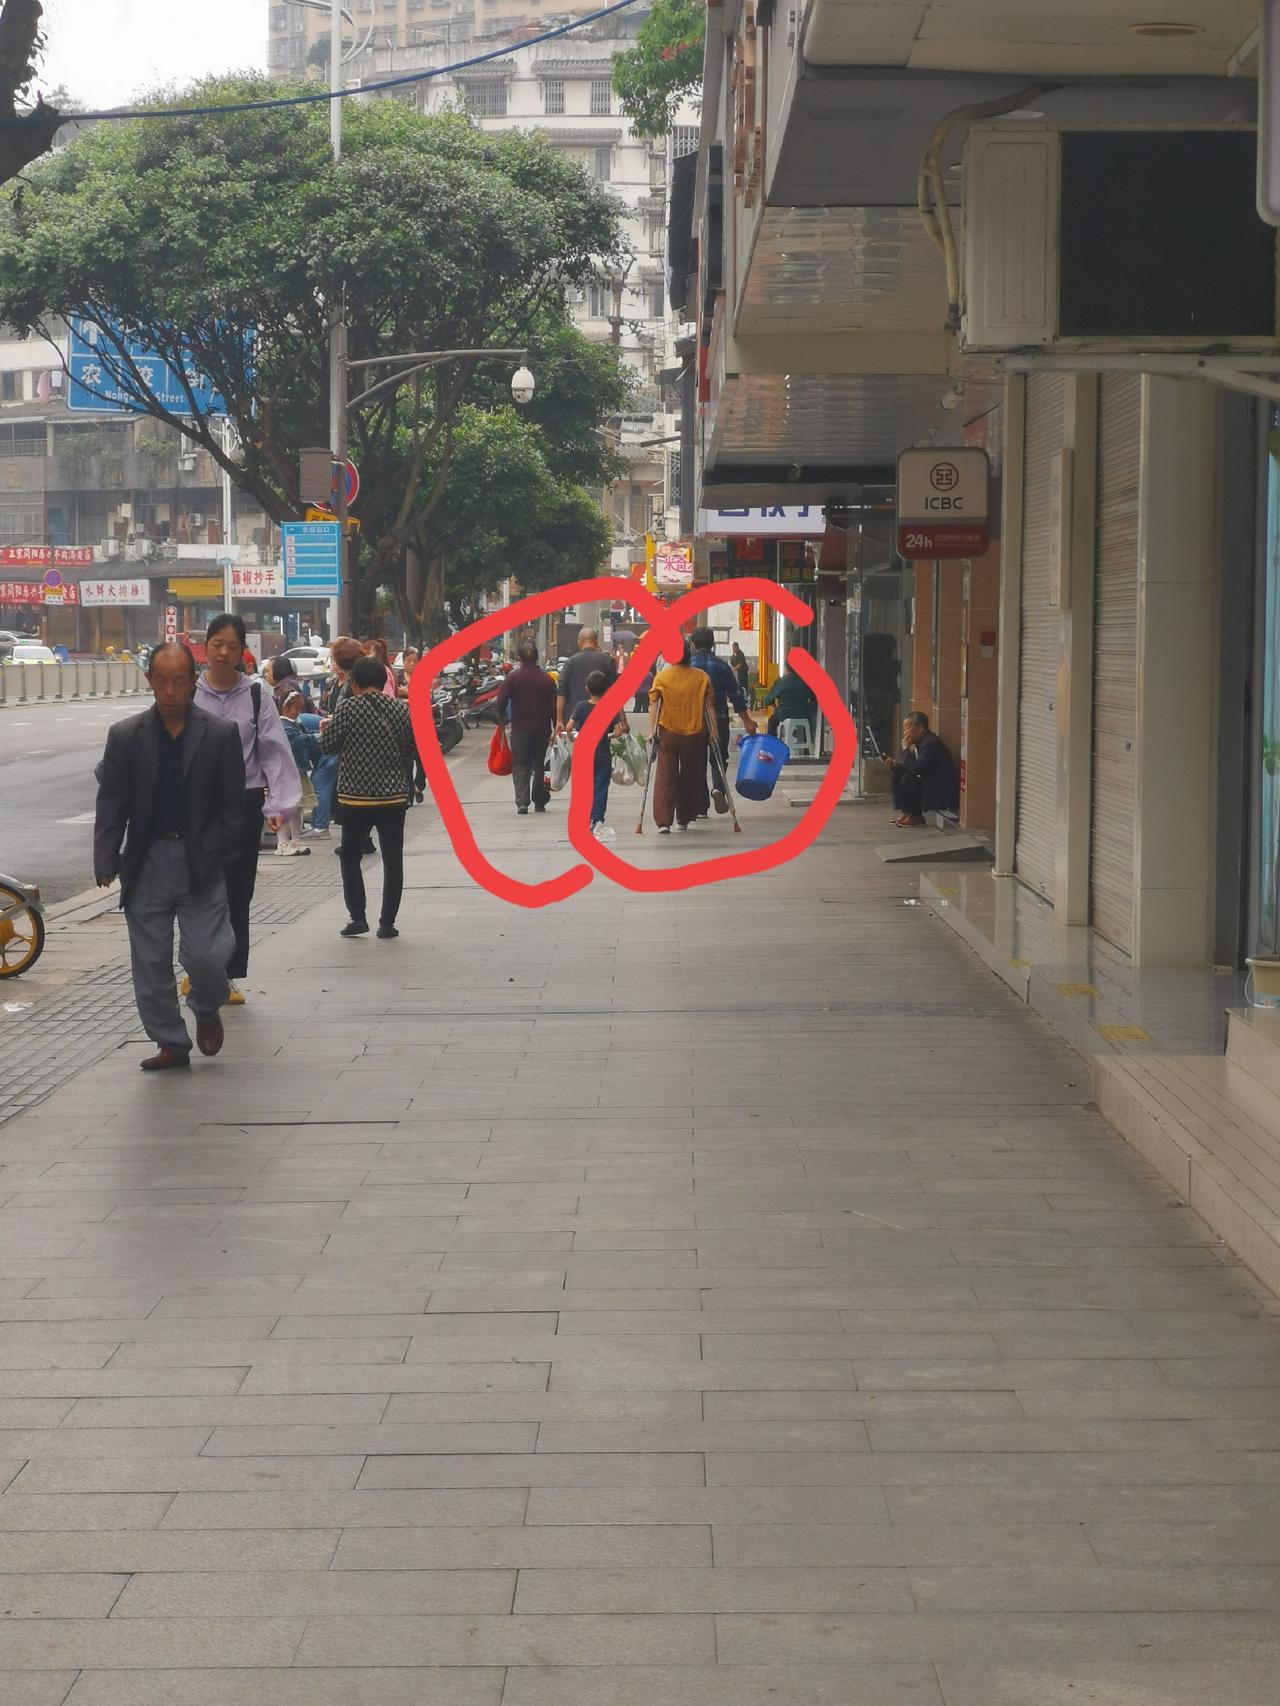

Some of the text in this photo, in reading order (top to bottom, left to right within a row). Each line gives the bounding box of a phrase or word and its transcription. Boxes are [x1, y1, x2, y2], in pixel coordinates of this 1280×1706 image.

[155, 391, 184, 403] Street
[924, 496, 964, 511] ICBC
[905, 534, 933, 549] 24h
